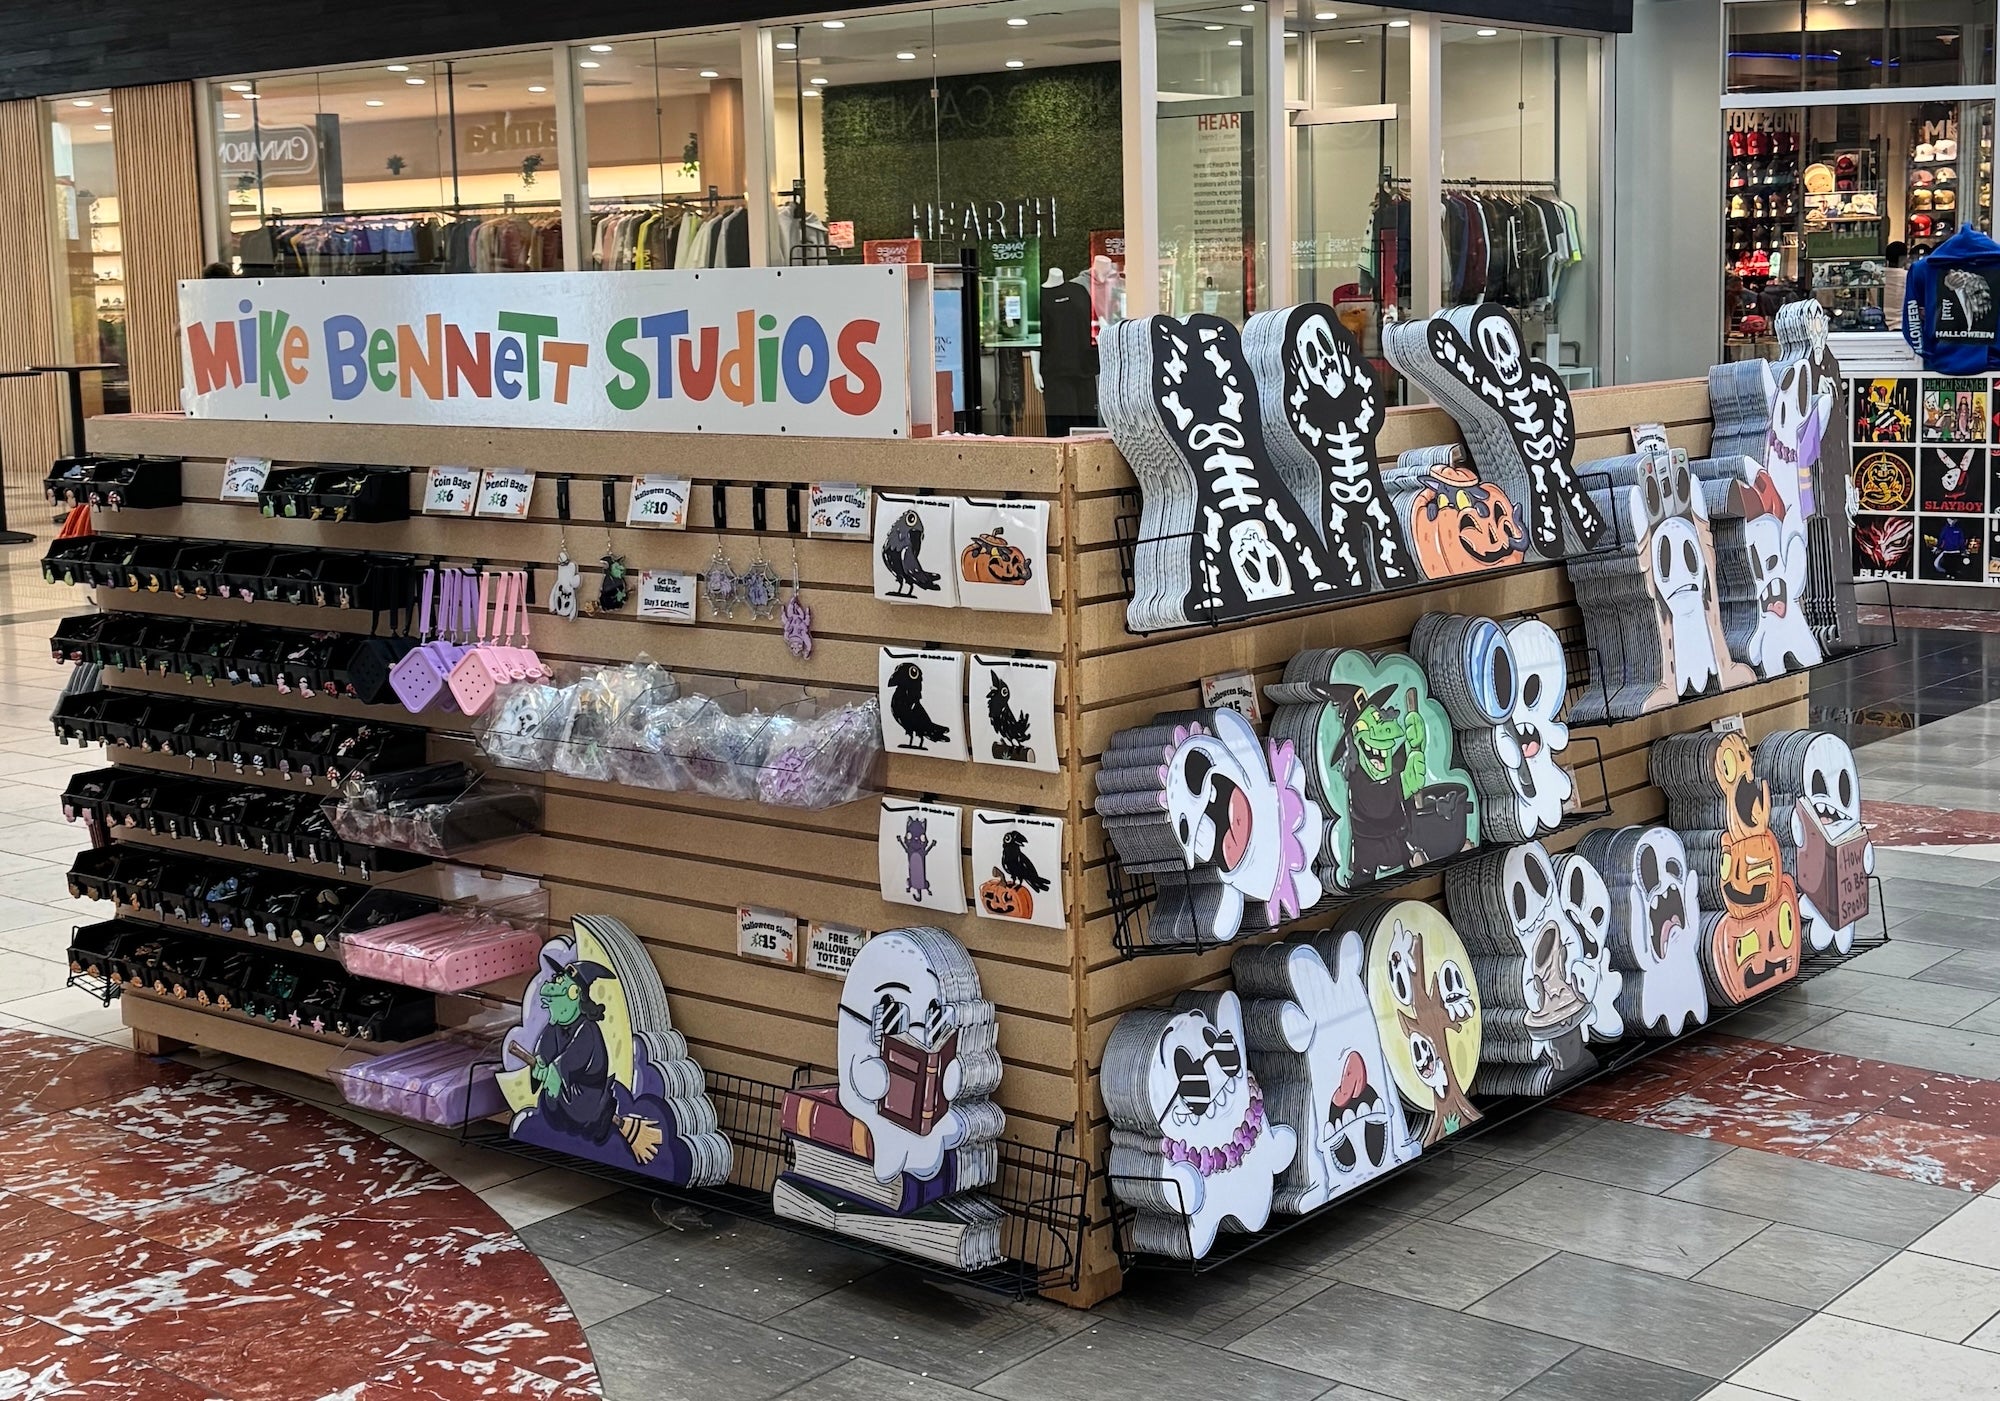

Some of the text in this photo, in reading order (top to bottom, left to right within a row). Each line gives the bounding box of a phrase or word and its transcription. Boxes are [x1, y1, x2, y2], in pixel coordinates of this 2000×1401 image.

[912, 196, 1057, 241] HEARTH
[1935, 330, 1995, 339] HALLOWEEN
[434, 476, 472, 490] Coin Bags
[485, 477, 529, 493] Pencil Bags
[446, 489, 454, 502] 6
[499, 494, 508, 507] 8
[813, 493, 866, 509] Window Clings
[1924, 501, 1984, 512] SLAYBOY
[1860, 568, 1907, 580] BLEACH
[742, 921, 793, 940] Halloween Signs
[828, 932, 849, 945] FREE
[817, 951, 839, 964] TOTE
